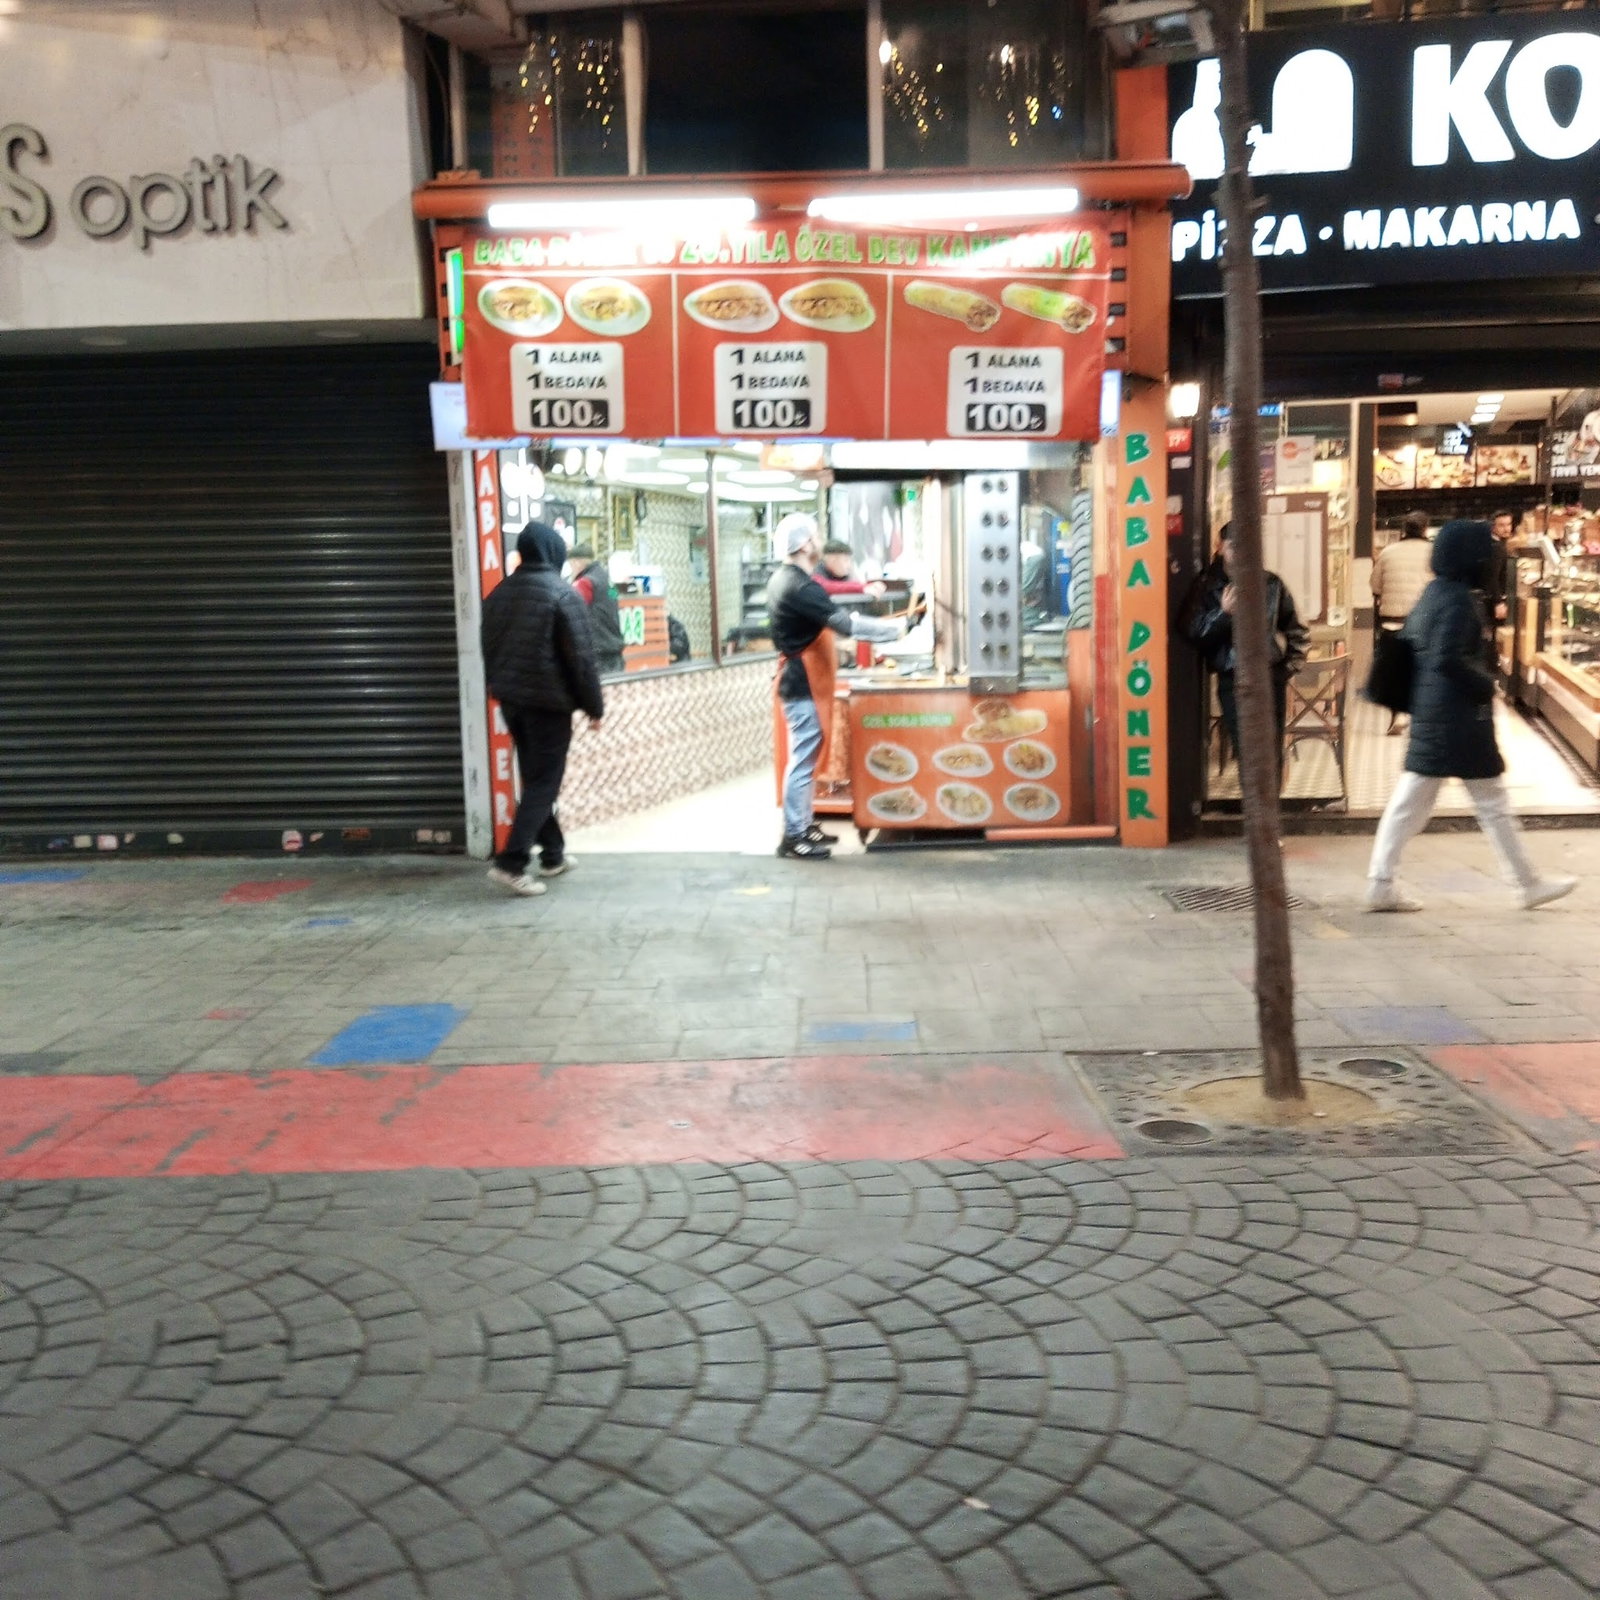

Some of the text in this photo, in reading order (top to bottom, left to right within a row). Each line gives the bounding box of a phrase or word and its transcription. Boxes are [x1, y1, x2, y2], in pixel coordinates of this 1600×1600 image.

[1412, 31, 1600, 167] KO
[71, 154, 288, 250] optik
[1172, 198, 1581, 262] PİZA MAKARNA
[795, 224, 862, 263] ÖZEL
[868, 236, 921, 265] DEV
[926, 231, 1096, 269] KAMYA
[525, 349, 540, 365] 1
[730, 349, 744, 365] 1
[965, 351, 979, 368] 1
[527, 372, 607, 390] 1 BEDAVA
[730, 373, 809, 390] 1 BEDAVA
[964, 377, 1046, 394] 1 BEDAVA
[1126, 433, 1158, 820] BABA DÖNER
